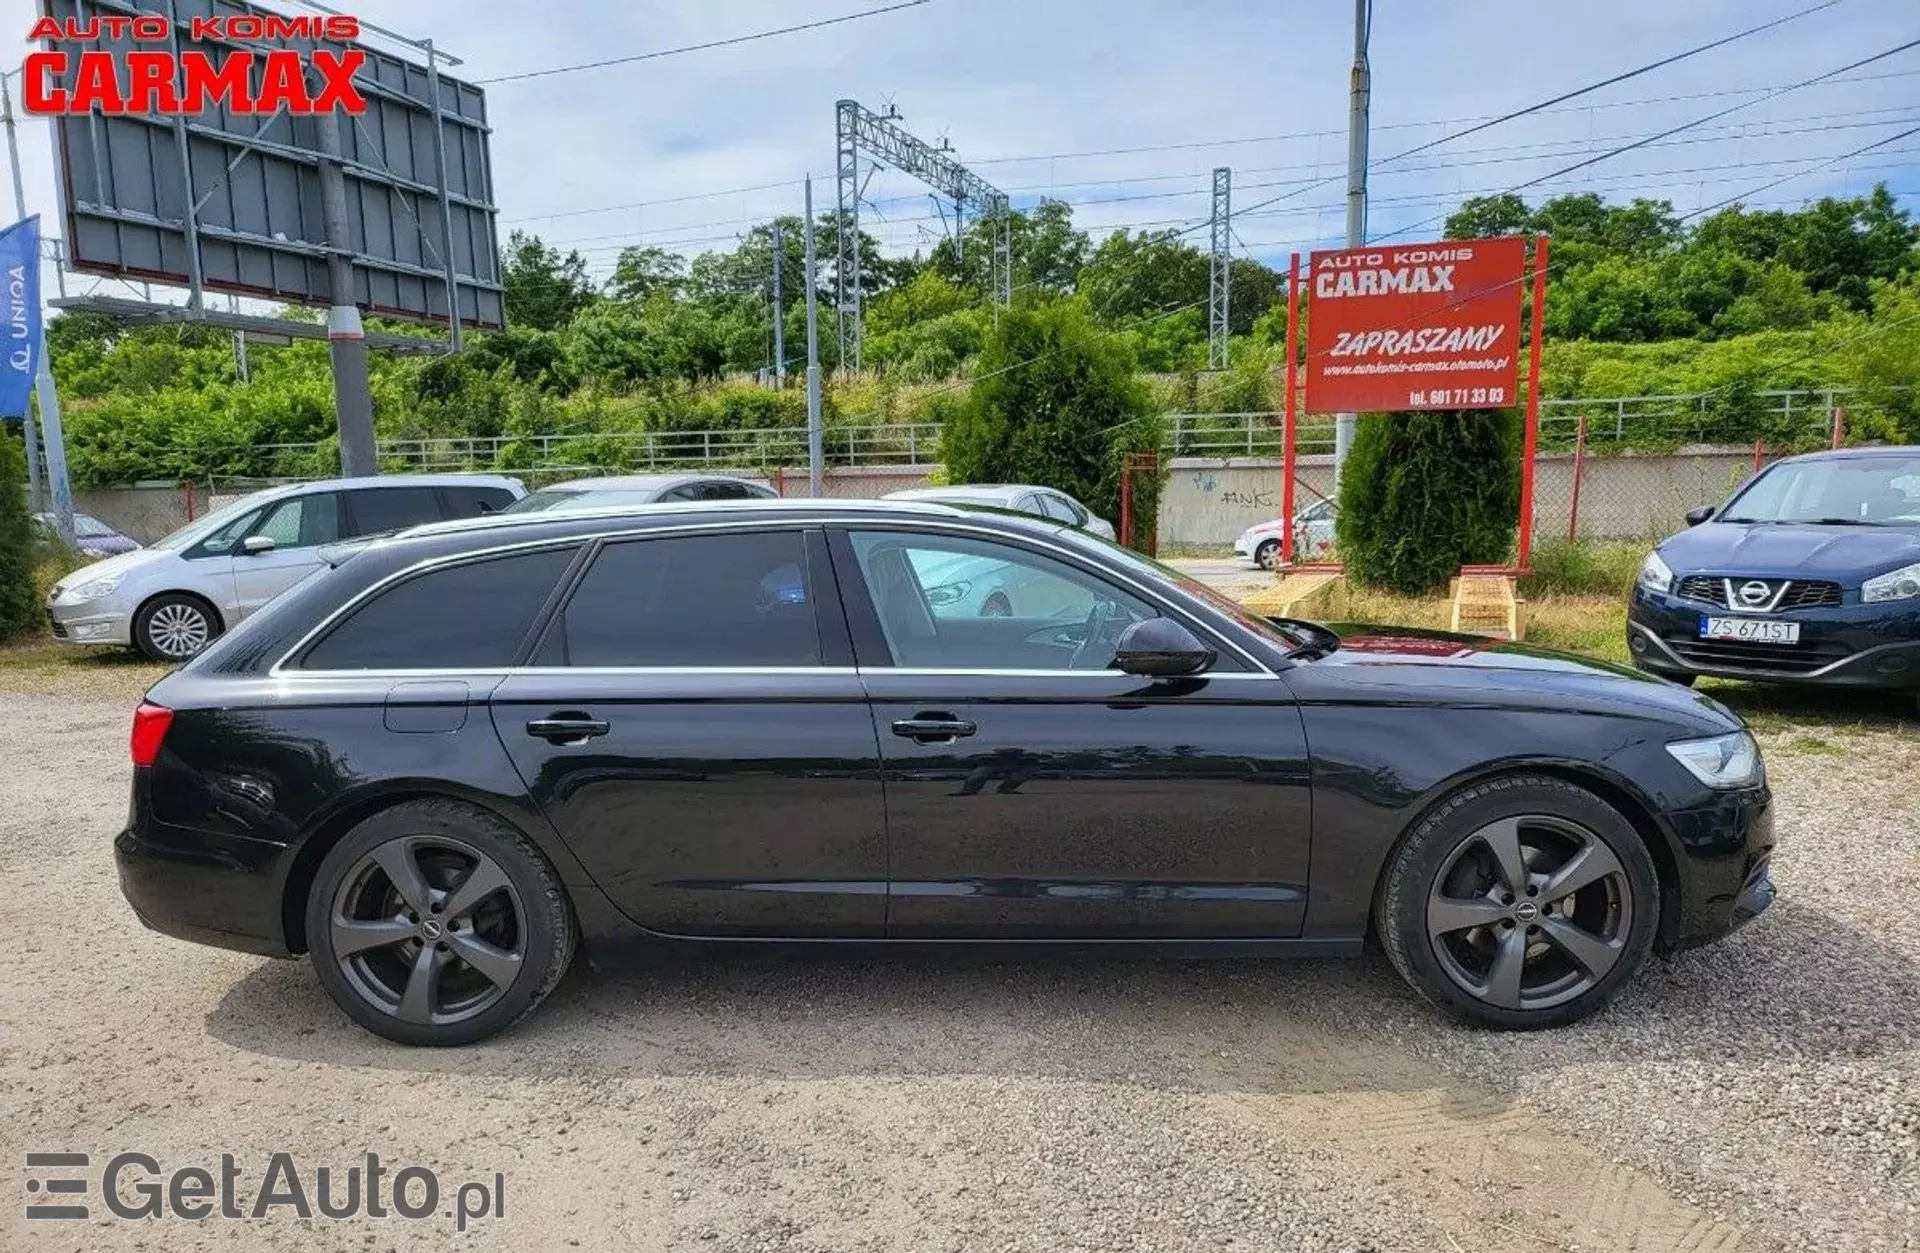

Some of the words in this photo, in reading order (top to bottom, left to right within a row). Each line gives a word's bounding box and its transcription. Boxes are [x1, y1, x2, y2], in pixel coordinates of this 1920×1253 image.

[1319, 254, 1383, 268] AUTO
[1394, 248, 1473, 264] KOMIS
[1316, 266, 1454, 297] CARMAX
[9, 266, 28, 338] UNIQA
[1330, 324, 1505, 357] ZAPRASZAMY
[1454, 388, 1469, 404] 71
[1471, 387, 1486, 404] 33
[1710, 619, 1733, 635] ZS
[1738, 621, 1795, 639] 671ST
